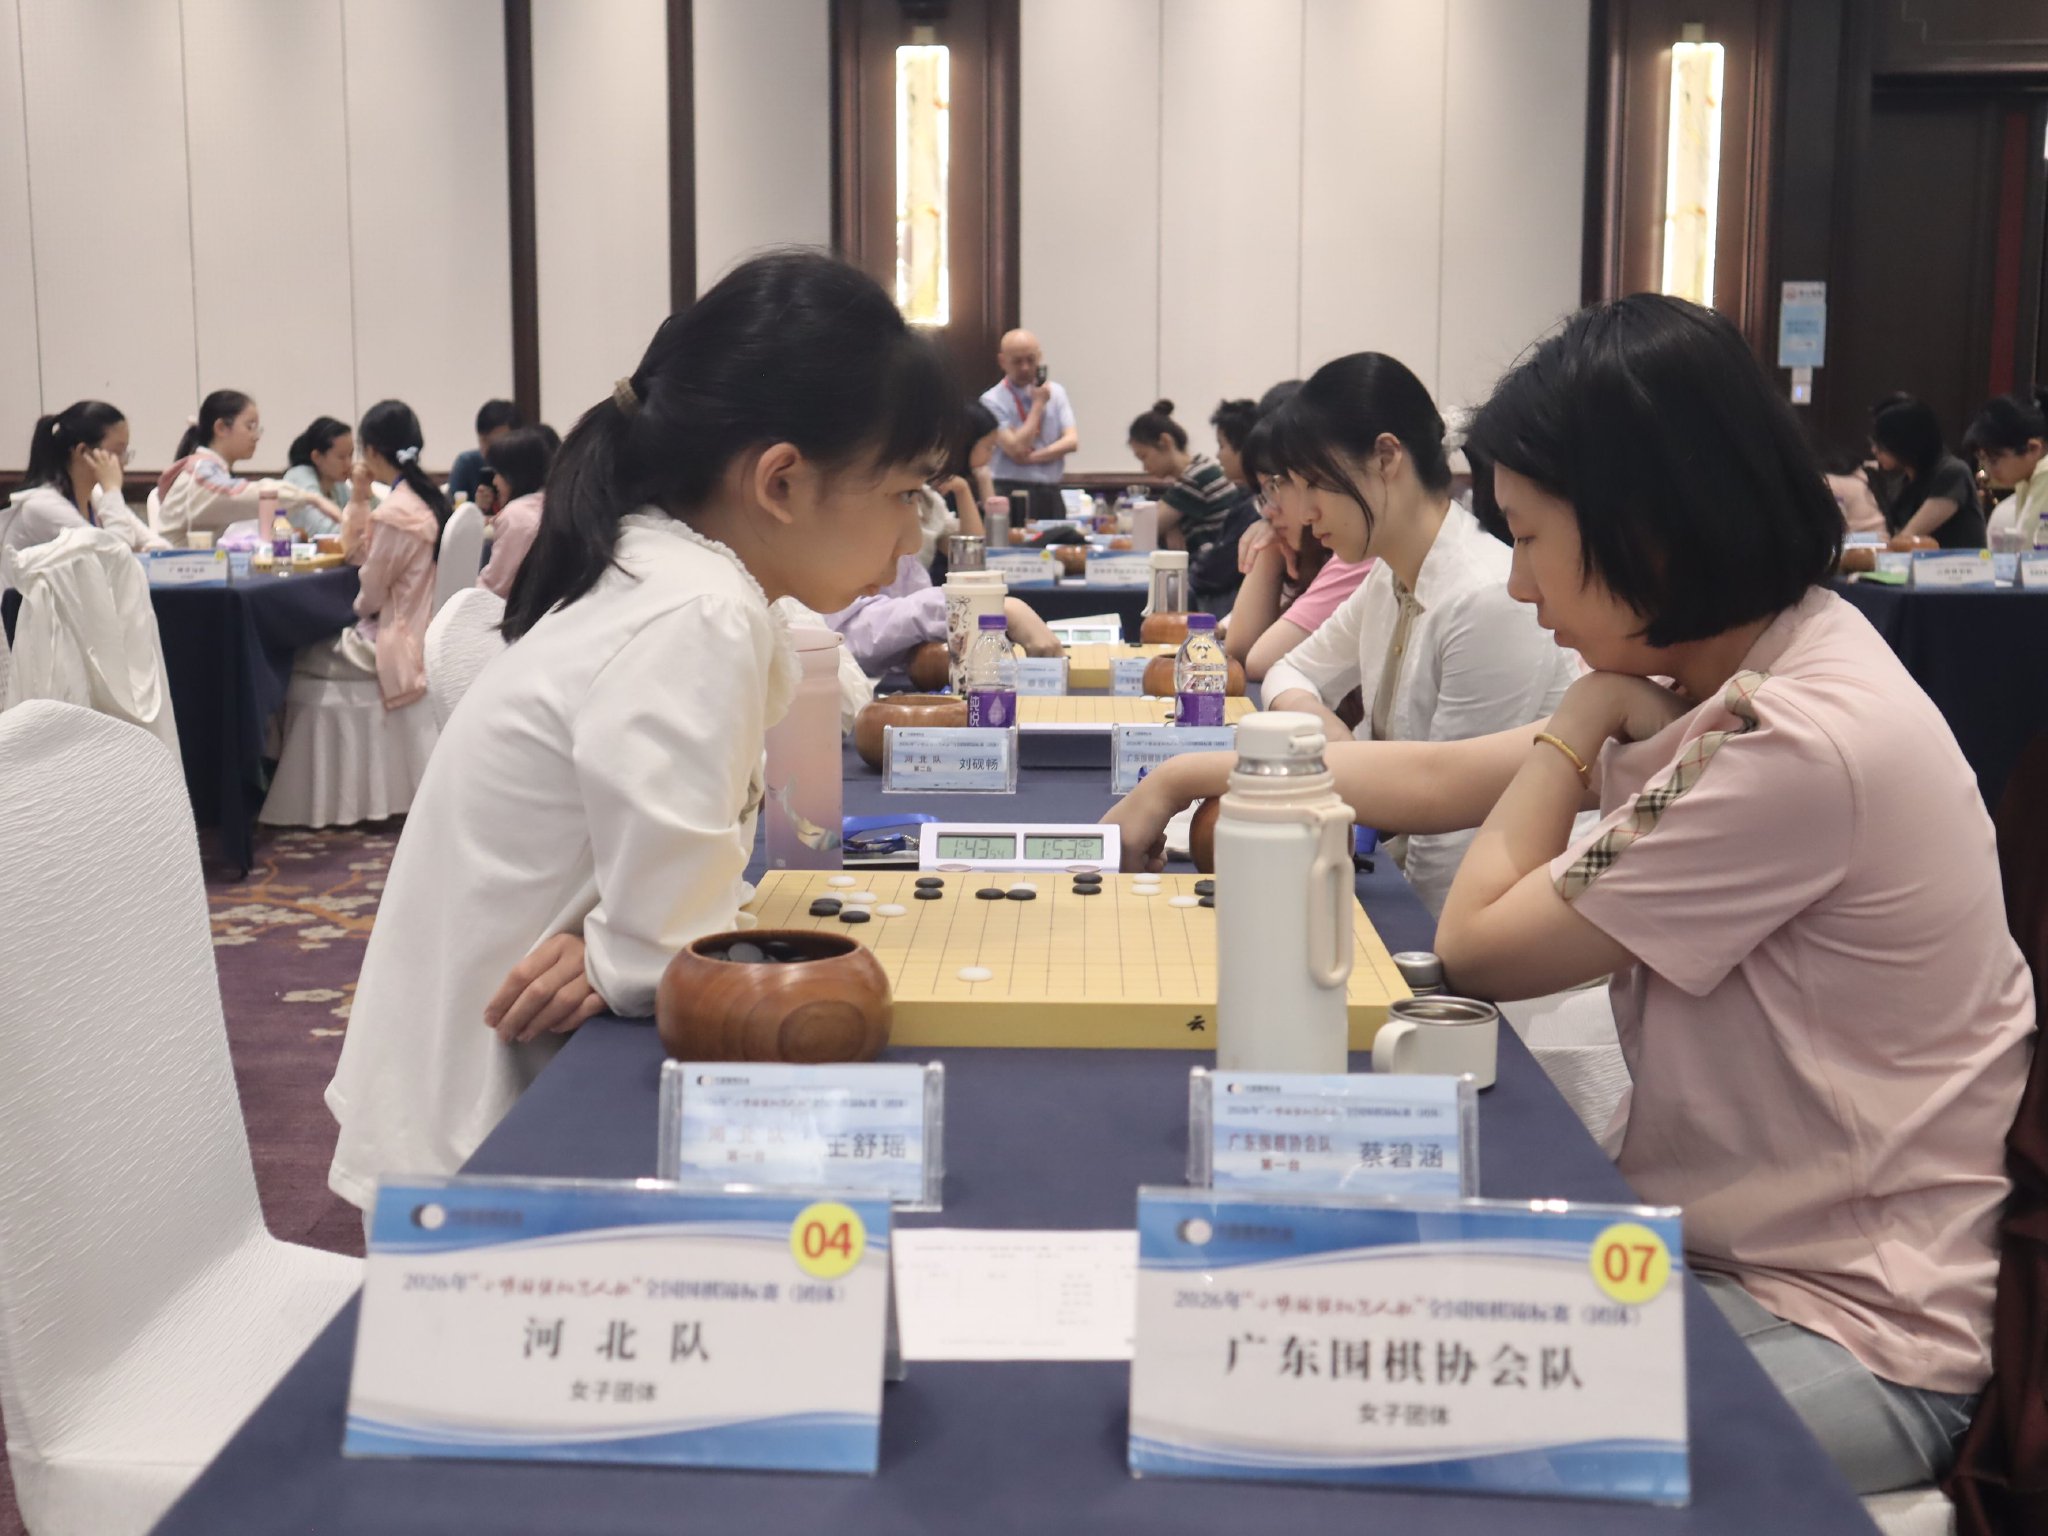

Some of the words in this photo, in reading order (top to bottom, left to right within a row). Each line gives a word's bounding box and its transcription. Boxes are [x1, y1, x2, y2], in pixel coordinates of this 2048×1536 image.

[953, 839, 990, 859] 1:43
[1041, 840, 1077, 860] 1:53
[801, 1221, 854, 1261] 04
[1602, 1242, 1659, 1286] 07
[522, 1316, 711, 1364] 河北队
[1225, 1333, 1586, 1390] 广东围棋协会队
[570, 1379, 657, 1403] 女子团体
[1357, 1402, 1451, 1427] 女子团体
